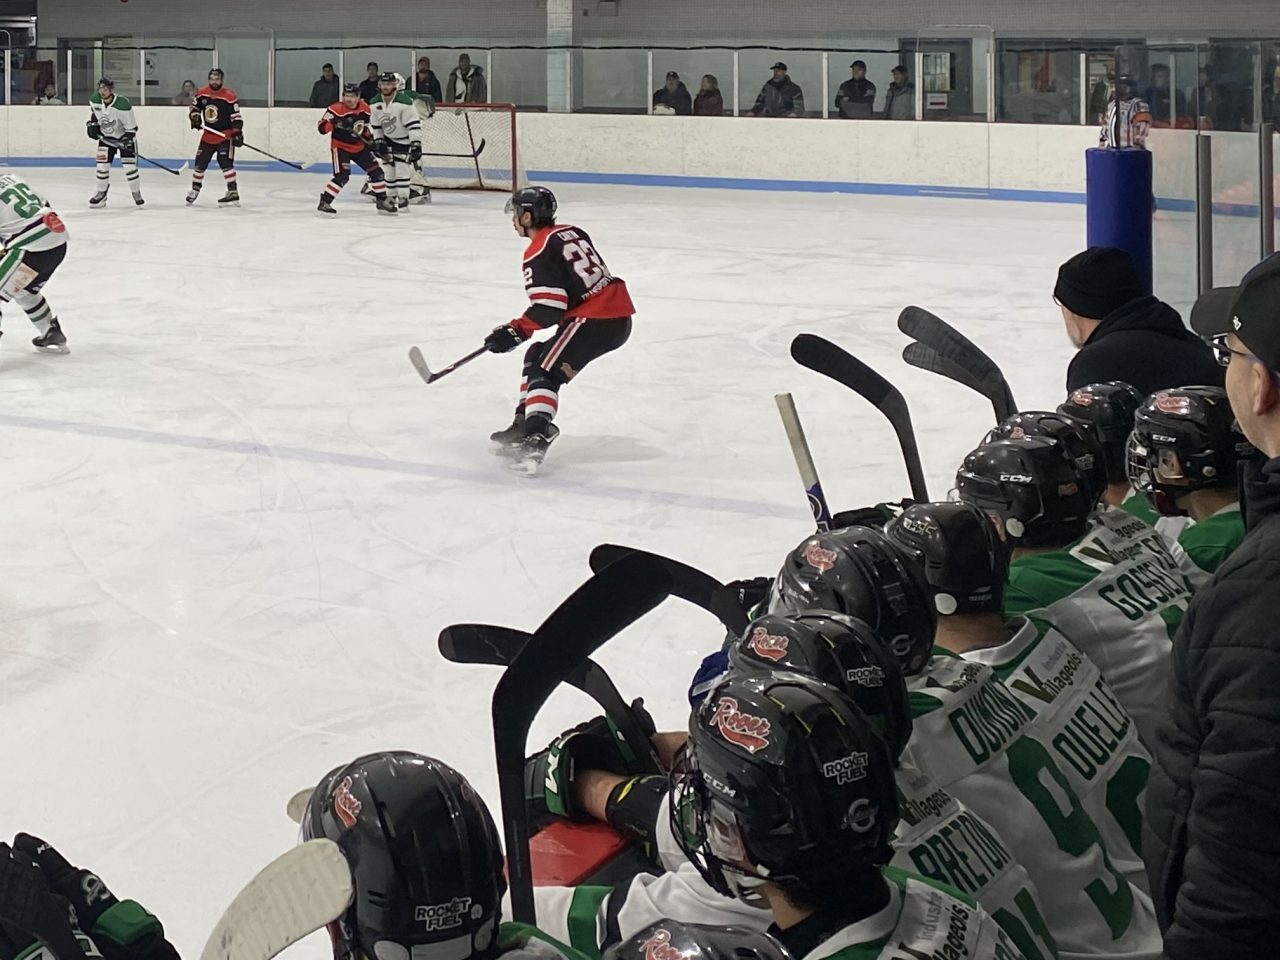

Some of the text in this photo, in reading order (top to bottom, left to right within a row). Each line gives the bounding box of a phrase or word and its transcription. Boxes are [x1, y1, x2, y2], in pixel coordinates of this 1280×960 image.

[1000, 474, 1033, 484] CCM
[823, 752, 870, 779] ROCKET
[836, 767, 868, 787] FUEL
[703, 771, 737, 798] CCM
[907, 809, 1013, 893] BRETON
[415, 897, 471, 921] ROCKET
[425, 912, 463, 932] FUEL
